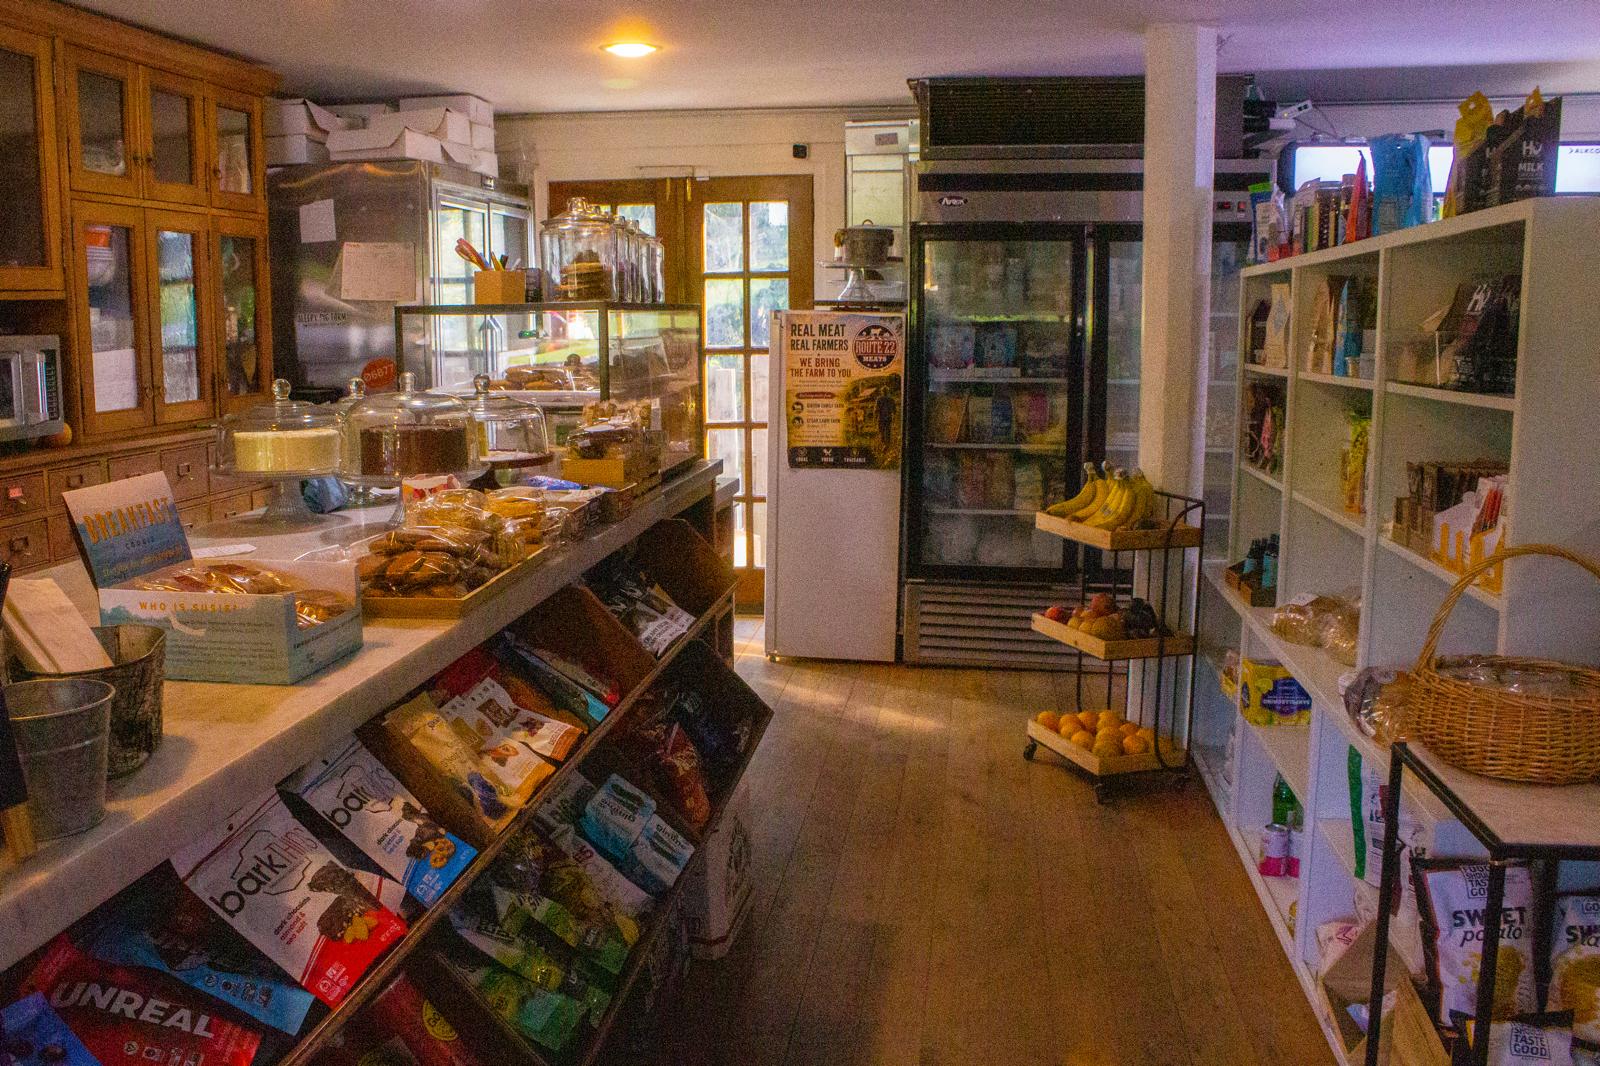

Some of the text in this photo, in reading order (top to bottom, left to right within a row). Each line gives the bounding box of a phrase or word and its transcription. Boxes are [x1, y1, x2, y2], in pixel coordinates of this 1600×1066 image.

[1519, 163, 1544, 172] MILK
[791, 324, 846, 337] REAL MEAT
[790, 339, 849, 351] REAL FARMERS
[856, 341, 896, 354] ROUTE 22
[800, 358, 840, 367] WE BRING
[790, 368, 804, 378] THE
[806, 368, 825, 378] FARM
[828, 368, 836, 378] TO
[838, 368, 852, 378] YOU
[83, 497, 174, 545] BREAKFAST
[139, 601, 167, 612] WHO
[172, 602, 186, 612] IS
[1452, 906, 1527, 928] SWET
[271, 918, 288, 936] dark
[277, 915, 302, 941] almond
[50, 981, 214, 1038] UNREAL
[1514, 1034, 1546, 1047] TASTE
[1514, 1043, 1547, 1057] GOOD
